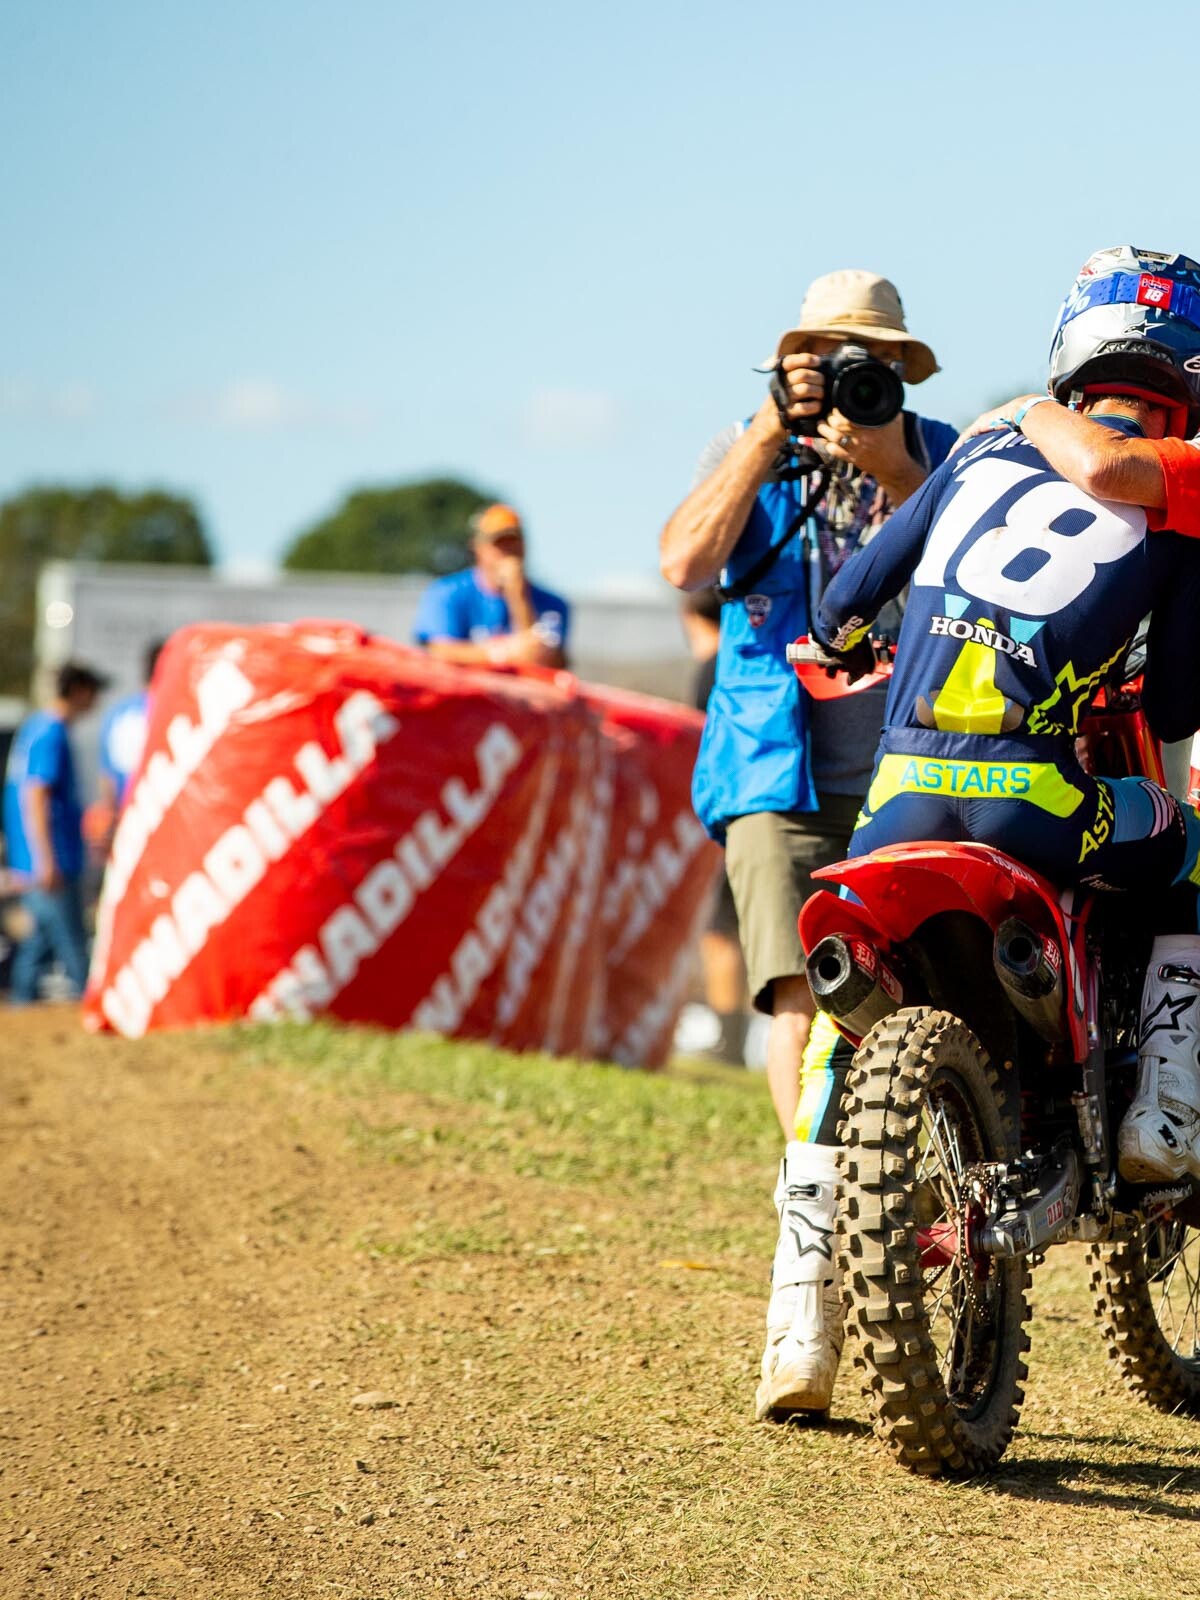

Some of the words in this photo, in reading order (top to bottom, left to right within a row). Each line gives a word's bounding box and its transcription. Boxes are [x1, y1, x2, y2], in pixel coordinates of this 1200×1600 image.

[1144, 288, 1164, 303] 18
[914, 457, 1148, 616] 18
[928, 615, 1038, 668] HONDA
[900, 759, 1031, 795] ASTARS
[102, 690, 400, 1040] UNADILLA
